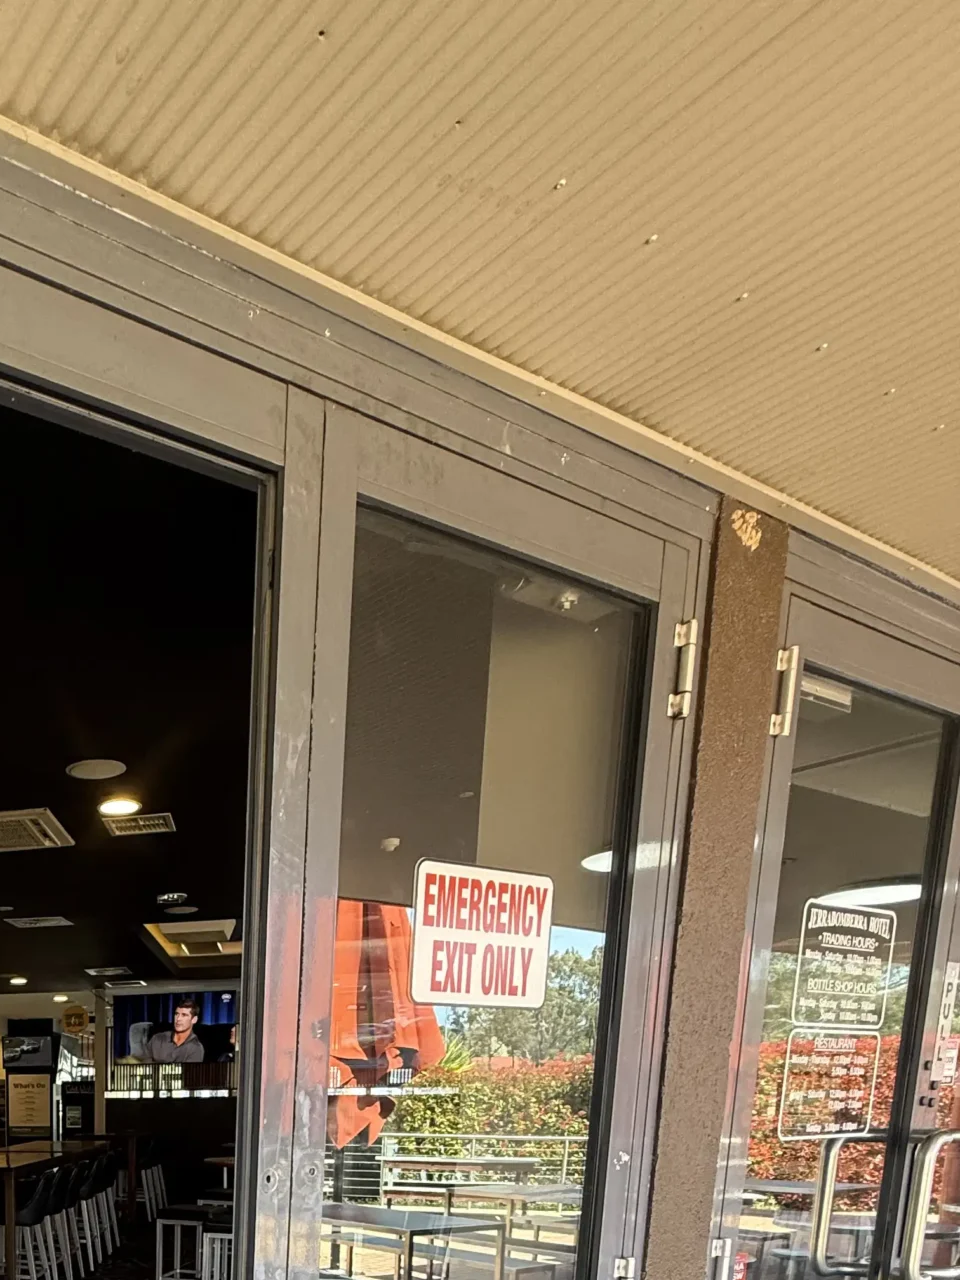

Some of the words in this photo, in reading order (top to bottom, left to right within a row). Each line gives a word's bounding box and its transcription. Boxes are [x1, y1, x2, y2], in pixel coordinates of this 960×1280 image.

[422, 872, 548, 938] EMERGENCY
[808, 907, 868, 930] JERRABOMBERRA
[869, 916, 891, 939] HOTEL
[822, 932, 851, 947] TRADING
[852, 936, 876, 950] HOURS
[430, 939, 477, 994] EXIT
[481, 943, 534, 997] ONLY
[807, 978, 834, 991] BOTTLE
[834, 980, 853, 992] SHOP
[854, 982, 877, 994] HOURS
[937, 982, 954, 1061] PULL
[814, 1037, 857, 1049] RESTAURANT
